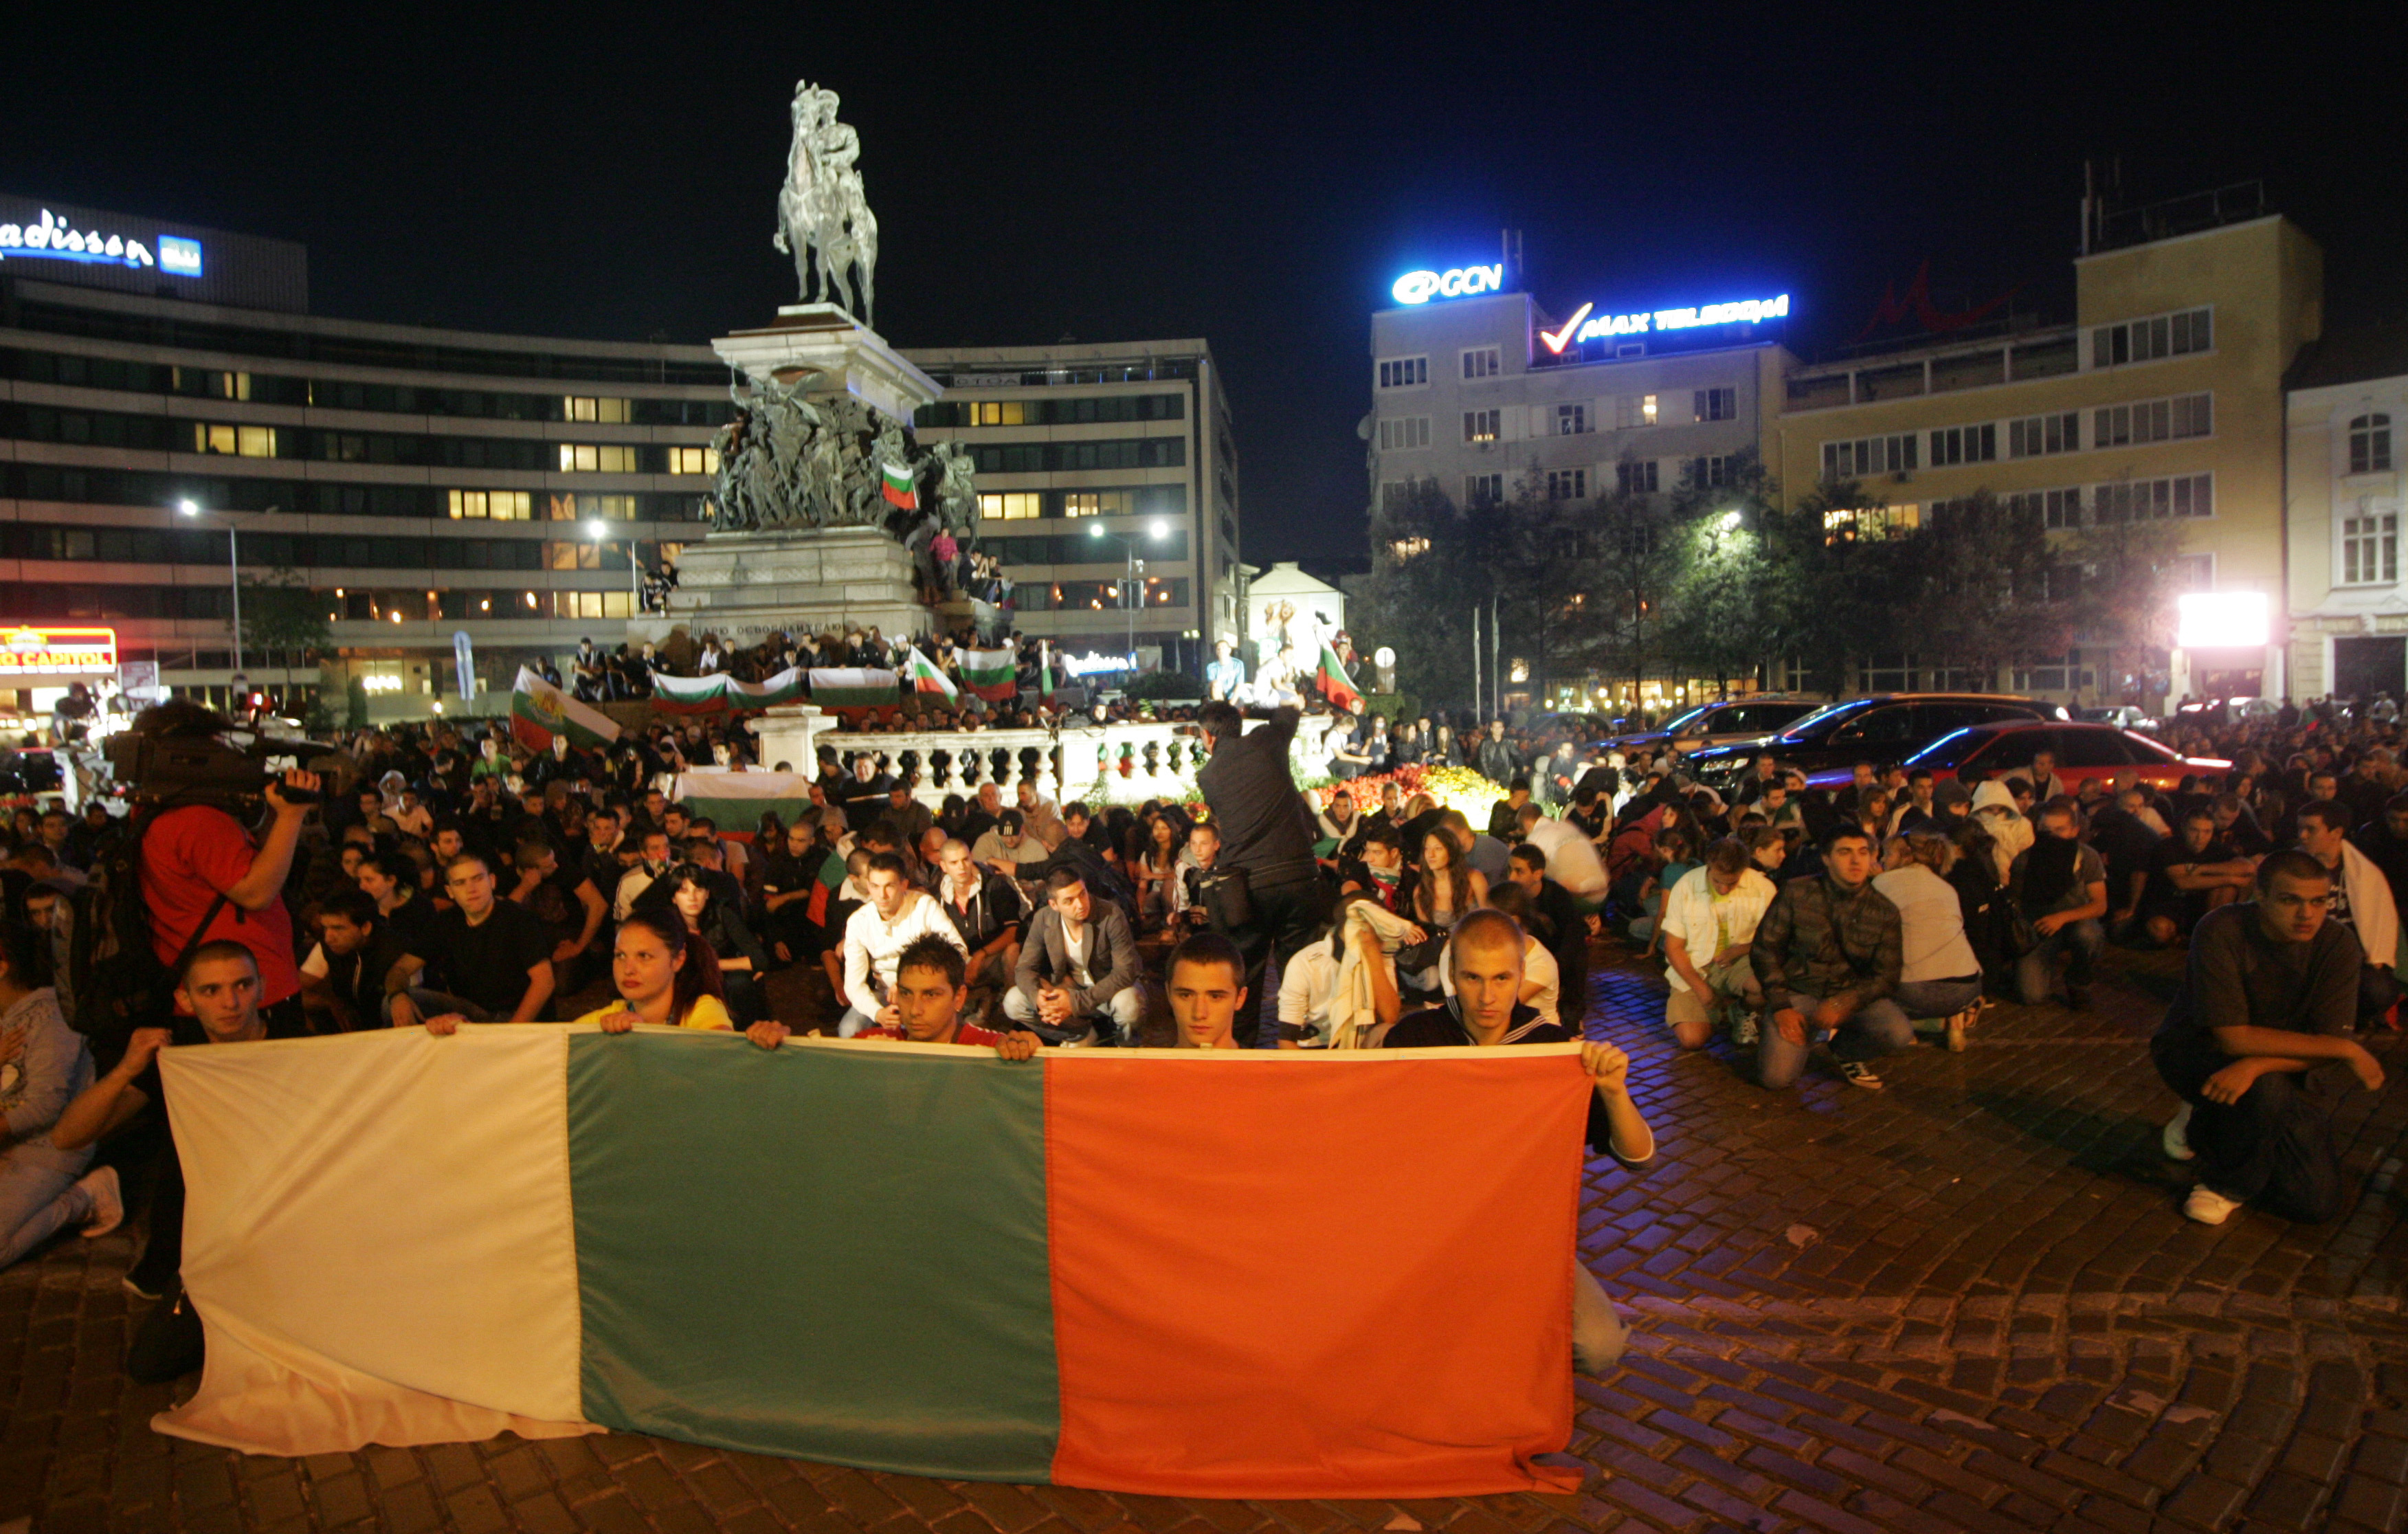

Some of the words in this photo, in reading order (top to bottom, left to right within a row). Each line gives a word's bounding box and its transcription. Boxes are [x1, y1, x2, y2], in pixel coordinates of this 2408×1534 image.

[0, 208, 154, 266] adisson
[1577, 313, 1651, 342] MAX
[1654, 294, 1789, 330] TELECOM
[22, 652, 109, 666] CAPITOL
